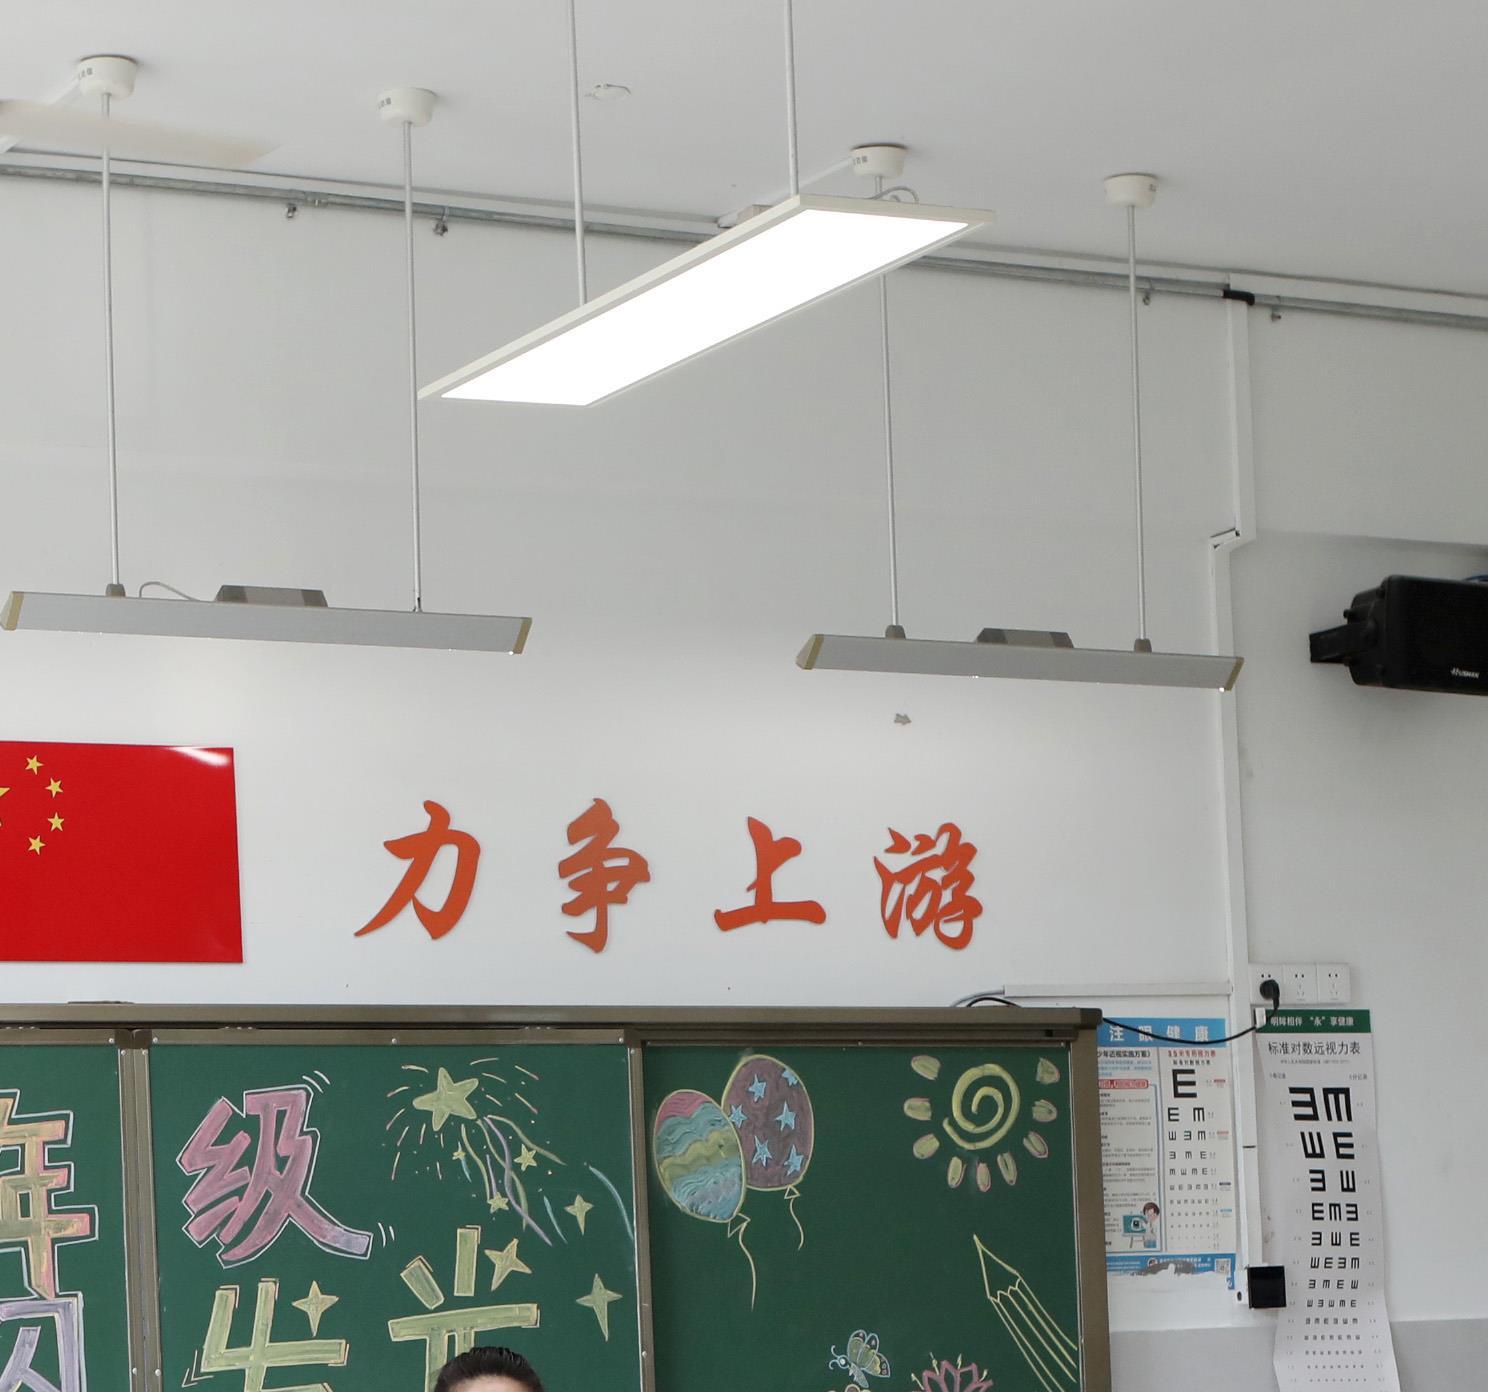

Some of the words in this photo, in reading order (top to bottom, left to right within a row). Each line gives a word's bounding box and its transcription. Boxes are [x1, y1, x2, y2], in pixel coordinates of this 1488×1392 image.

[354, 797, 983, 953] 力争上游
[1268, 1041, 1361, 1055] 标准对数远视力表
